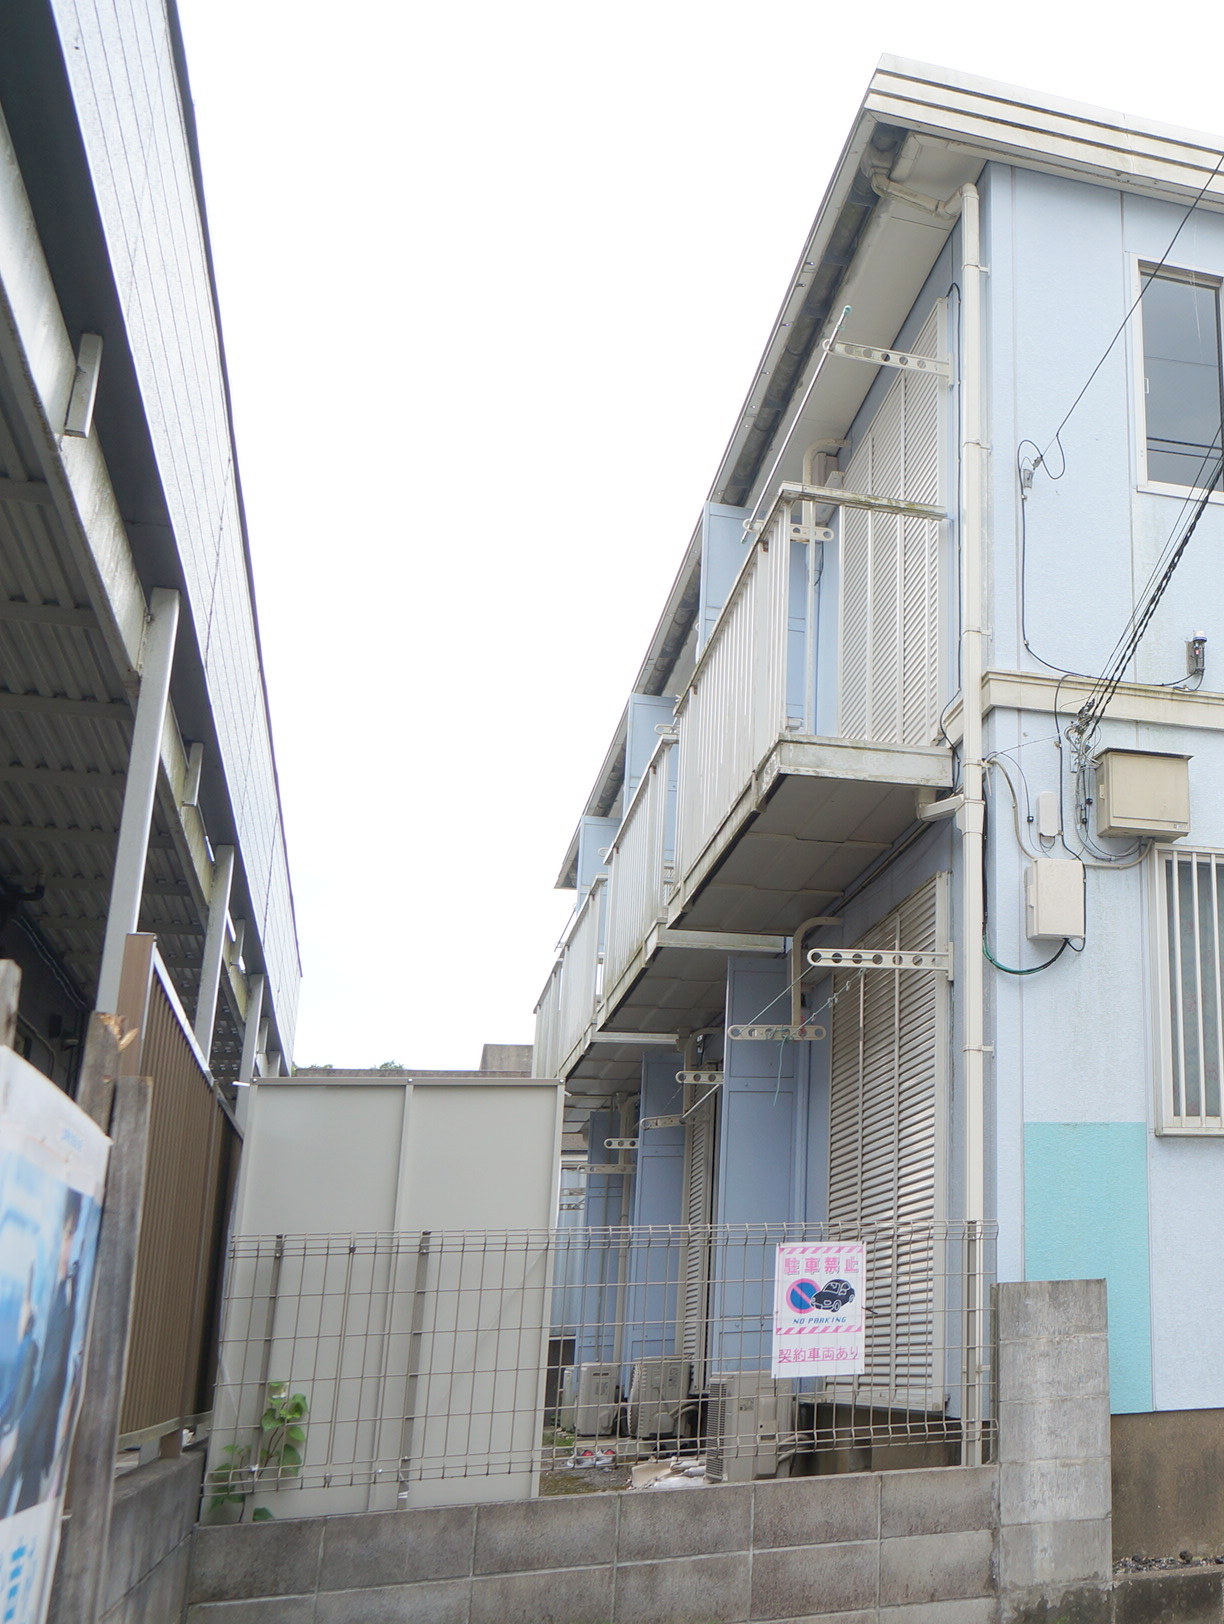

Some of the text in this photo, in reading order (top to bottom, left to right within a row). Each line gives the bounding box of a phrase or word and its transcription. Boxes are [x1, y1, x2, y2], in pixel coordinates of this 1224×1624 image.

[784, 1256, 860, 1275] 駐車禁止
[808, 1316, 847, 1325] PARKING
[778, 1347, 859, 1363] 契約車両あり
